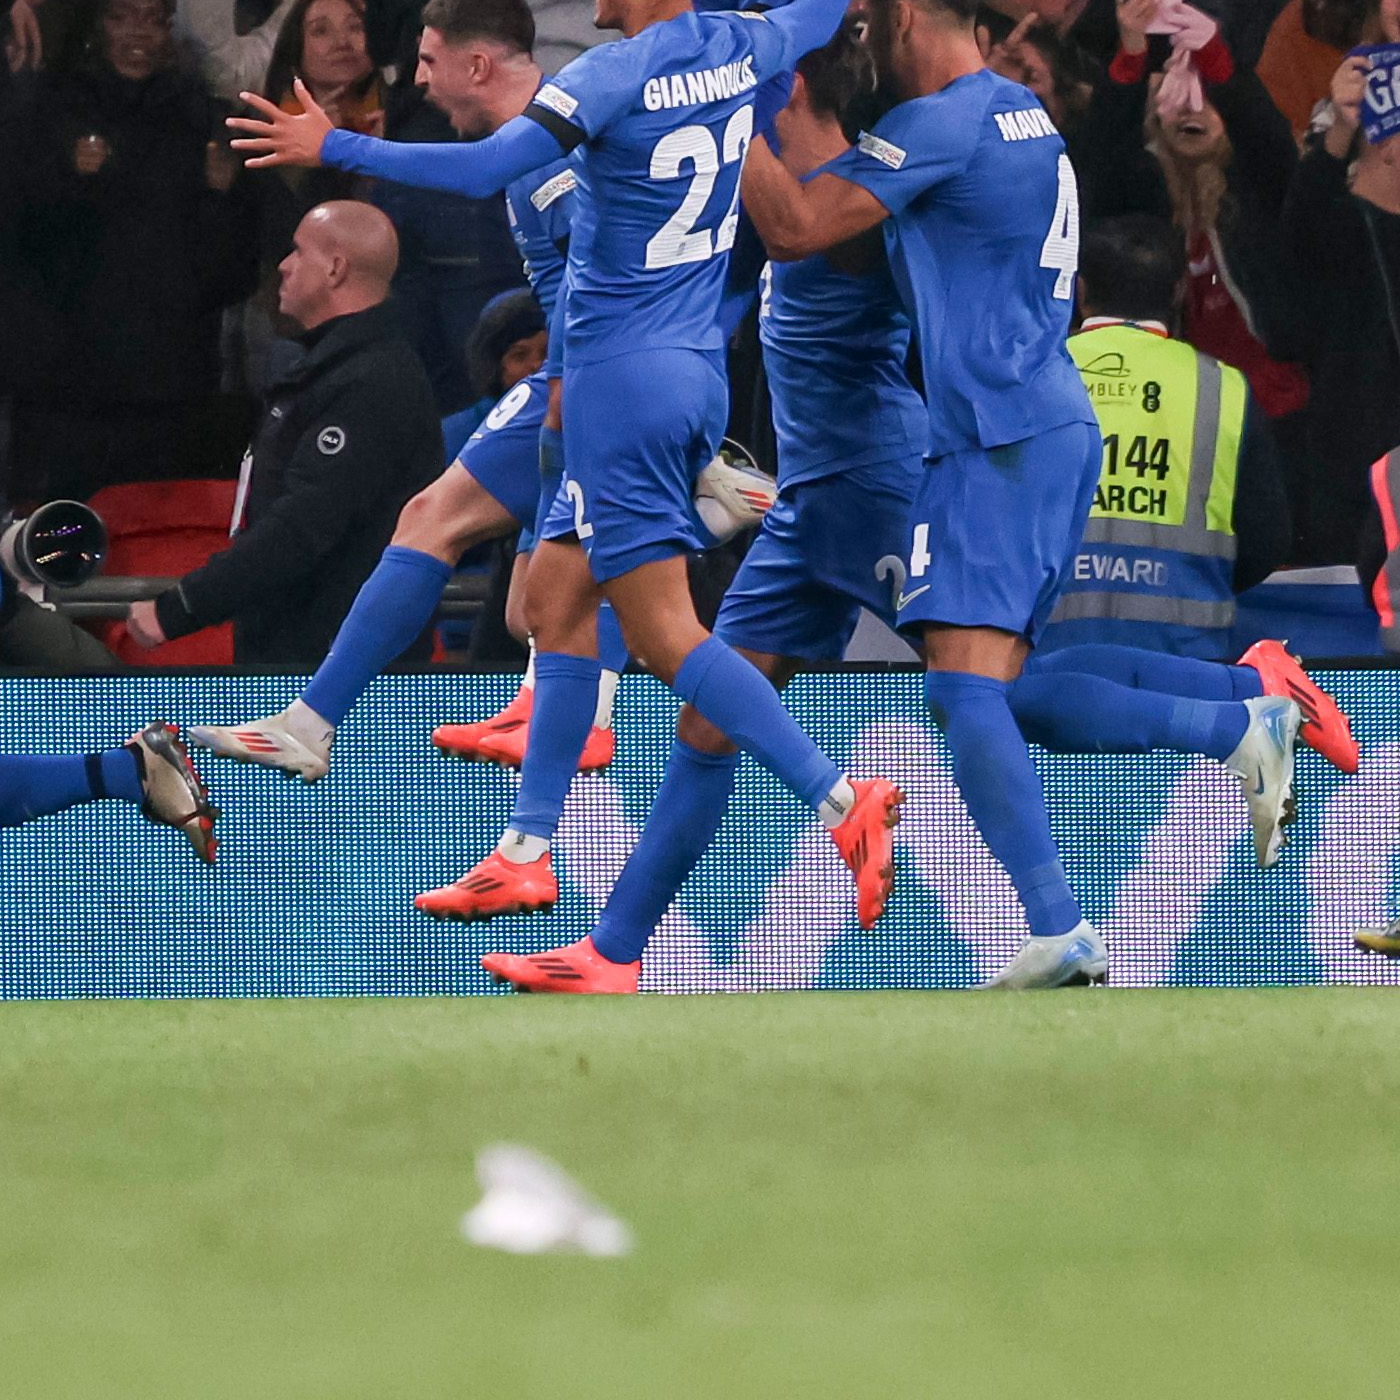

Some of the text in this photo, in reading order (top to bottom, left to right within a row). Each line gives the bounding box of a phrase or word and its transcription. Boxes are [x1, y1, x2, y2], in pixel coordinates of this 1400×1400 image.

[644, 103, 755, 269] 22
[1038, 153, 1080, 301] 4
[486, 382, 532, 431] 9
[1103, 433, 1170, 481] 144
[566, 480, 594, 540] 2
[910, 523, 931, 577] 4
